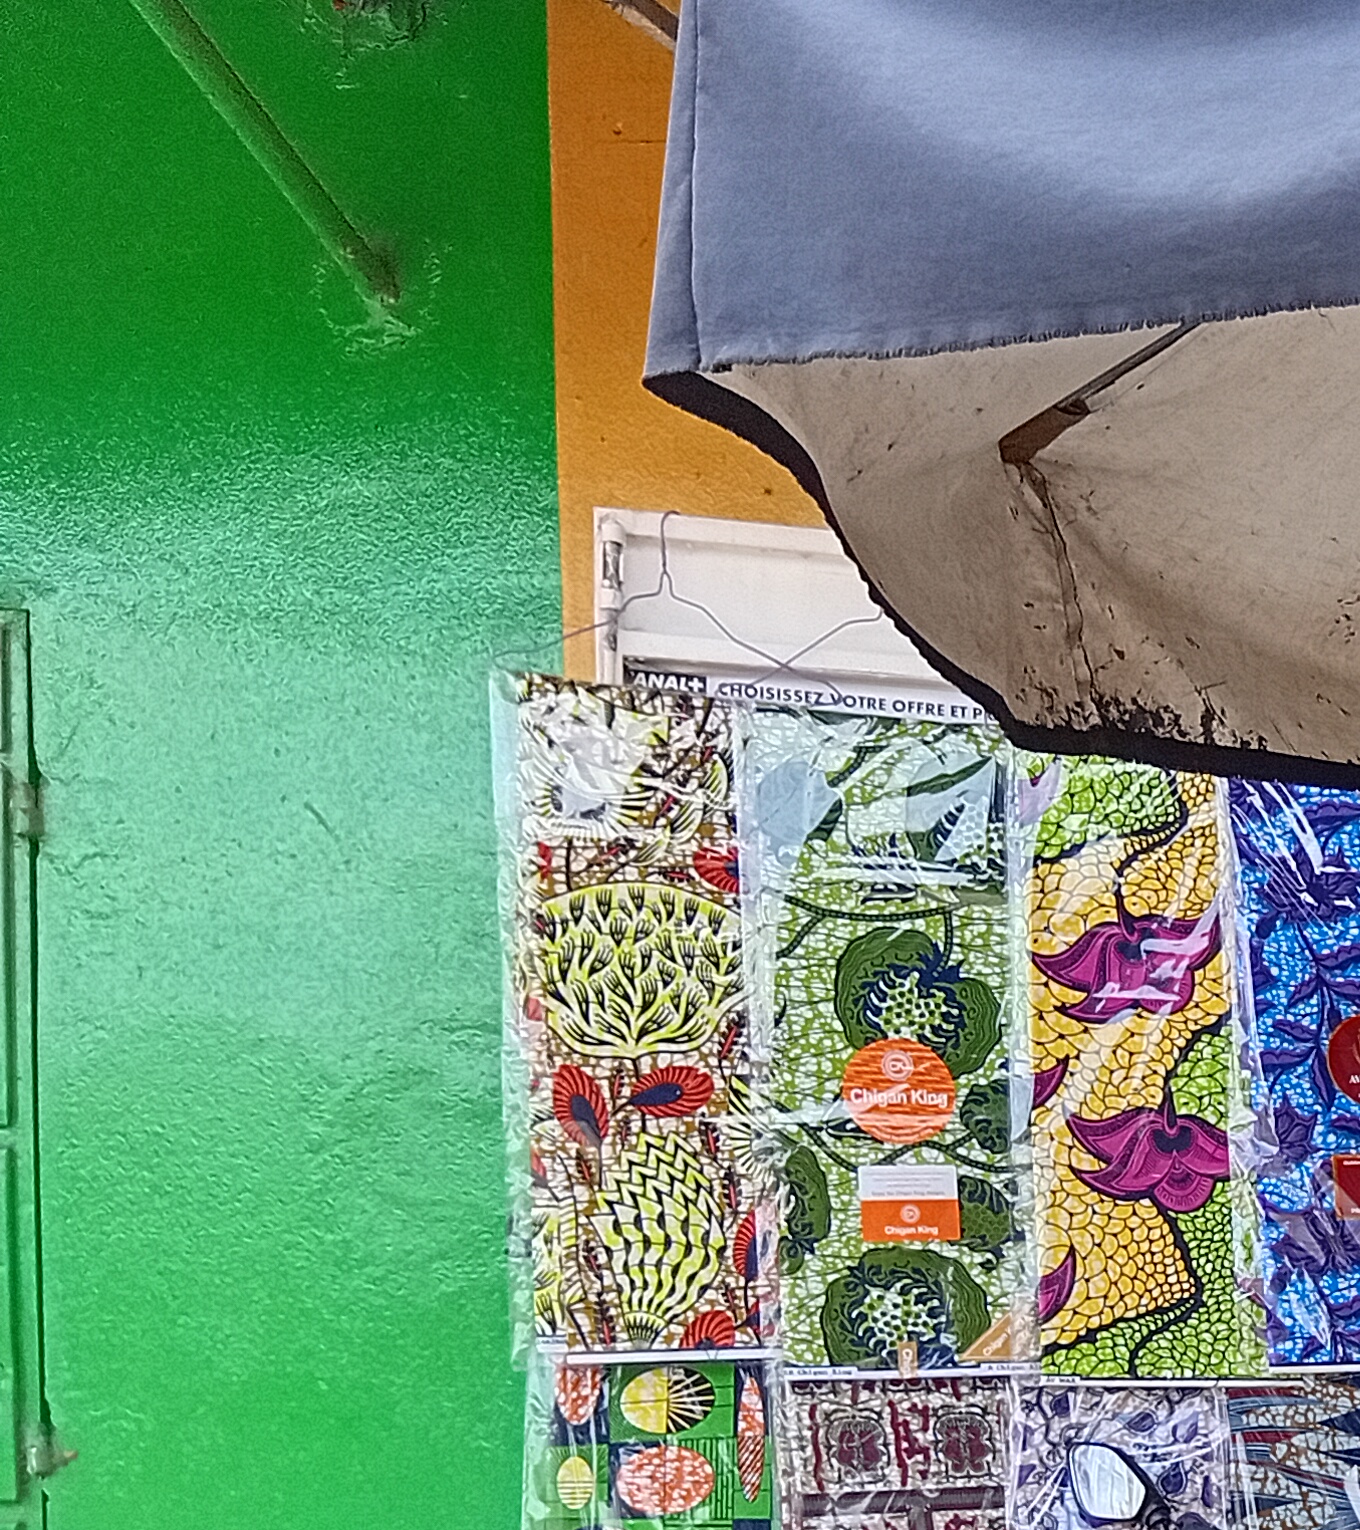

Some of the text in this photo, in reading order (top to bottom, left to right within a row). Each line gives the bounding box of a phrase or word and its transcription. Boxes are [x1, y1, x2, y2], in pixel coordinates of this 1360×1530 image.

[630, 669, 706, 693] ANAL+
[717, 682, 968, 719] CHOISISSEZ VOTRE OFFRE ET
[850, 1088, 948, 1108] Chigan King
